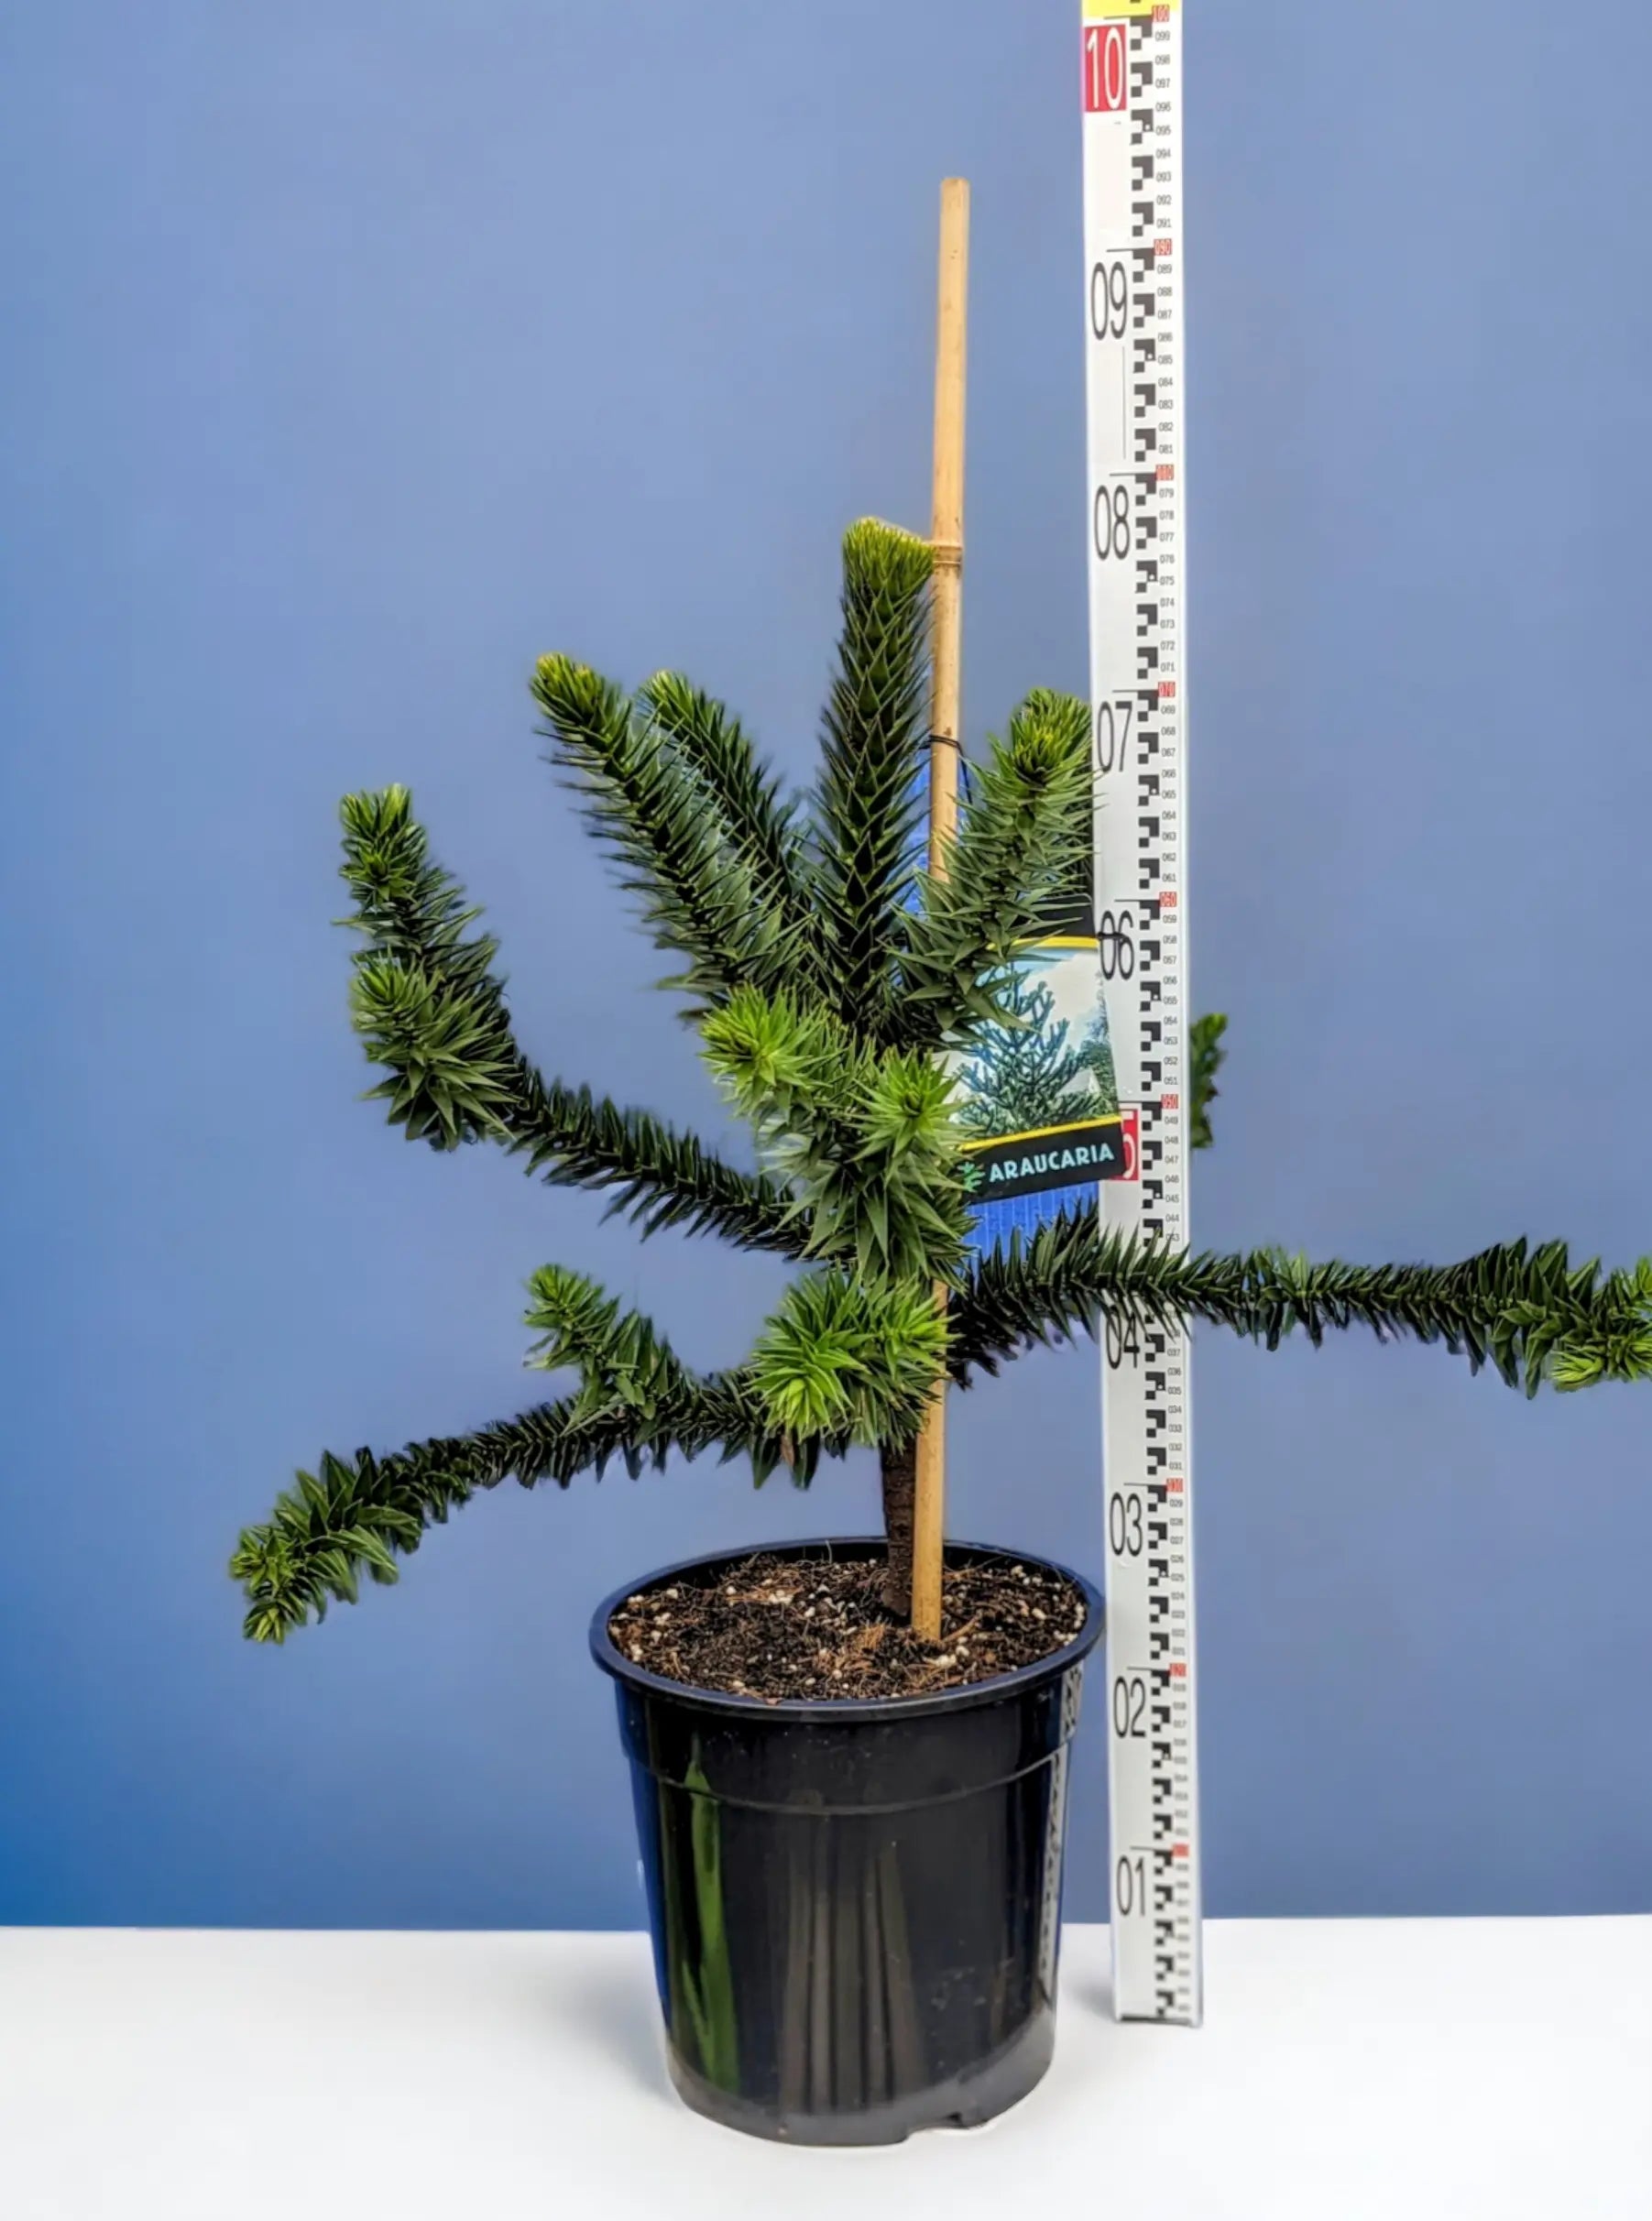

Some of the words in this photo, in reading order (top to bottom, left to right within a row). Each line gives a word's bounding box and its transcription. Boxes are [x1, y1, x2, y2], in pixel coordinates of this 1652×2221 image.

[1087, 27, 1124, 110] 10
[1155, 148, 1171, 159] 094
[1156, 193, 1171, 205] 092
[1156, 217, 1171, 228] 091
[1090, 261, 1128, 341] 09
[1094, 485, 1131, 560] 08
[1097, 700, 1132, 773] 07
[1100, 910, 1135, 980] 06
[989, 1143, 1114, 1183] ARAUCARIA
[1106, 1305, 1140, 1371] 04
[1110, 1492, 1143, 1557] 03
[1113, 1676, 1146, 1738] 02
[1116, 1855, 1145, 1917] 01
